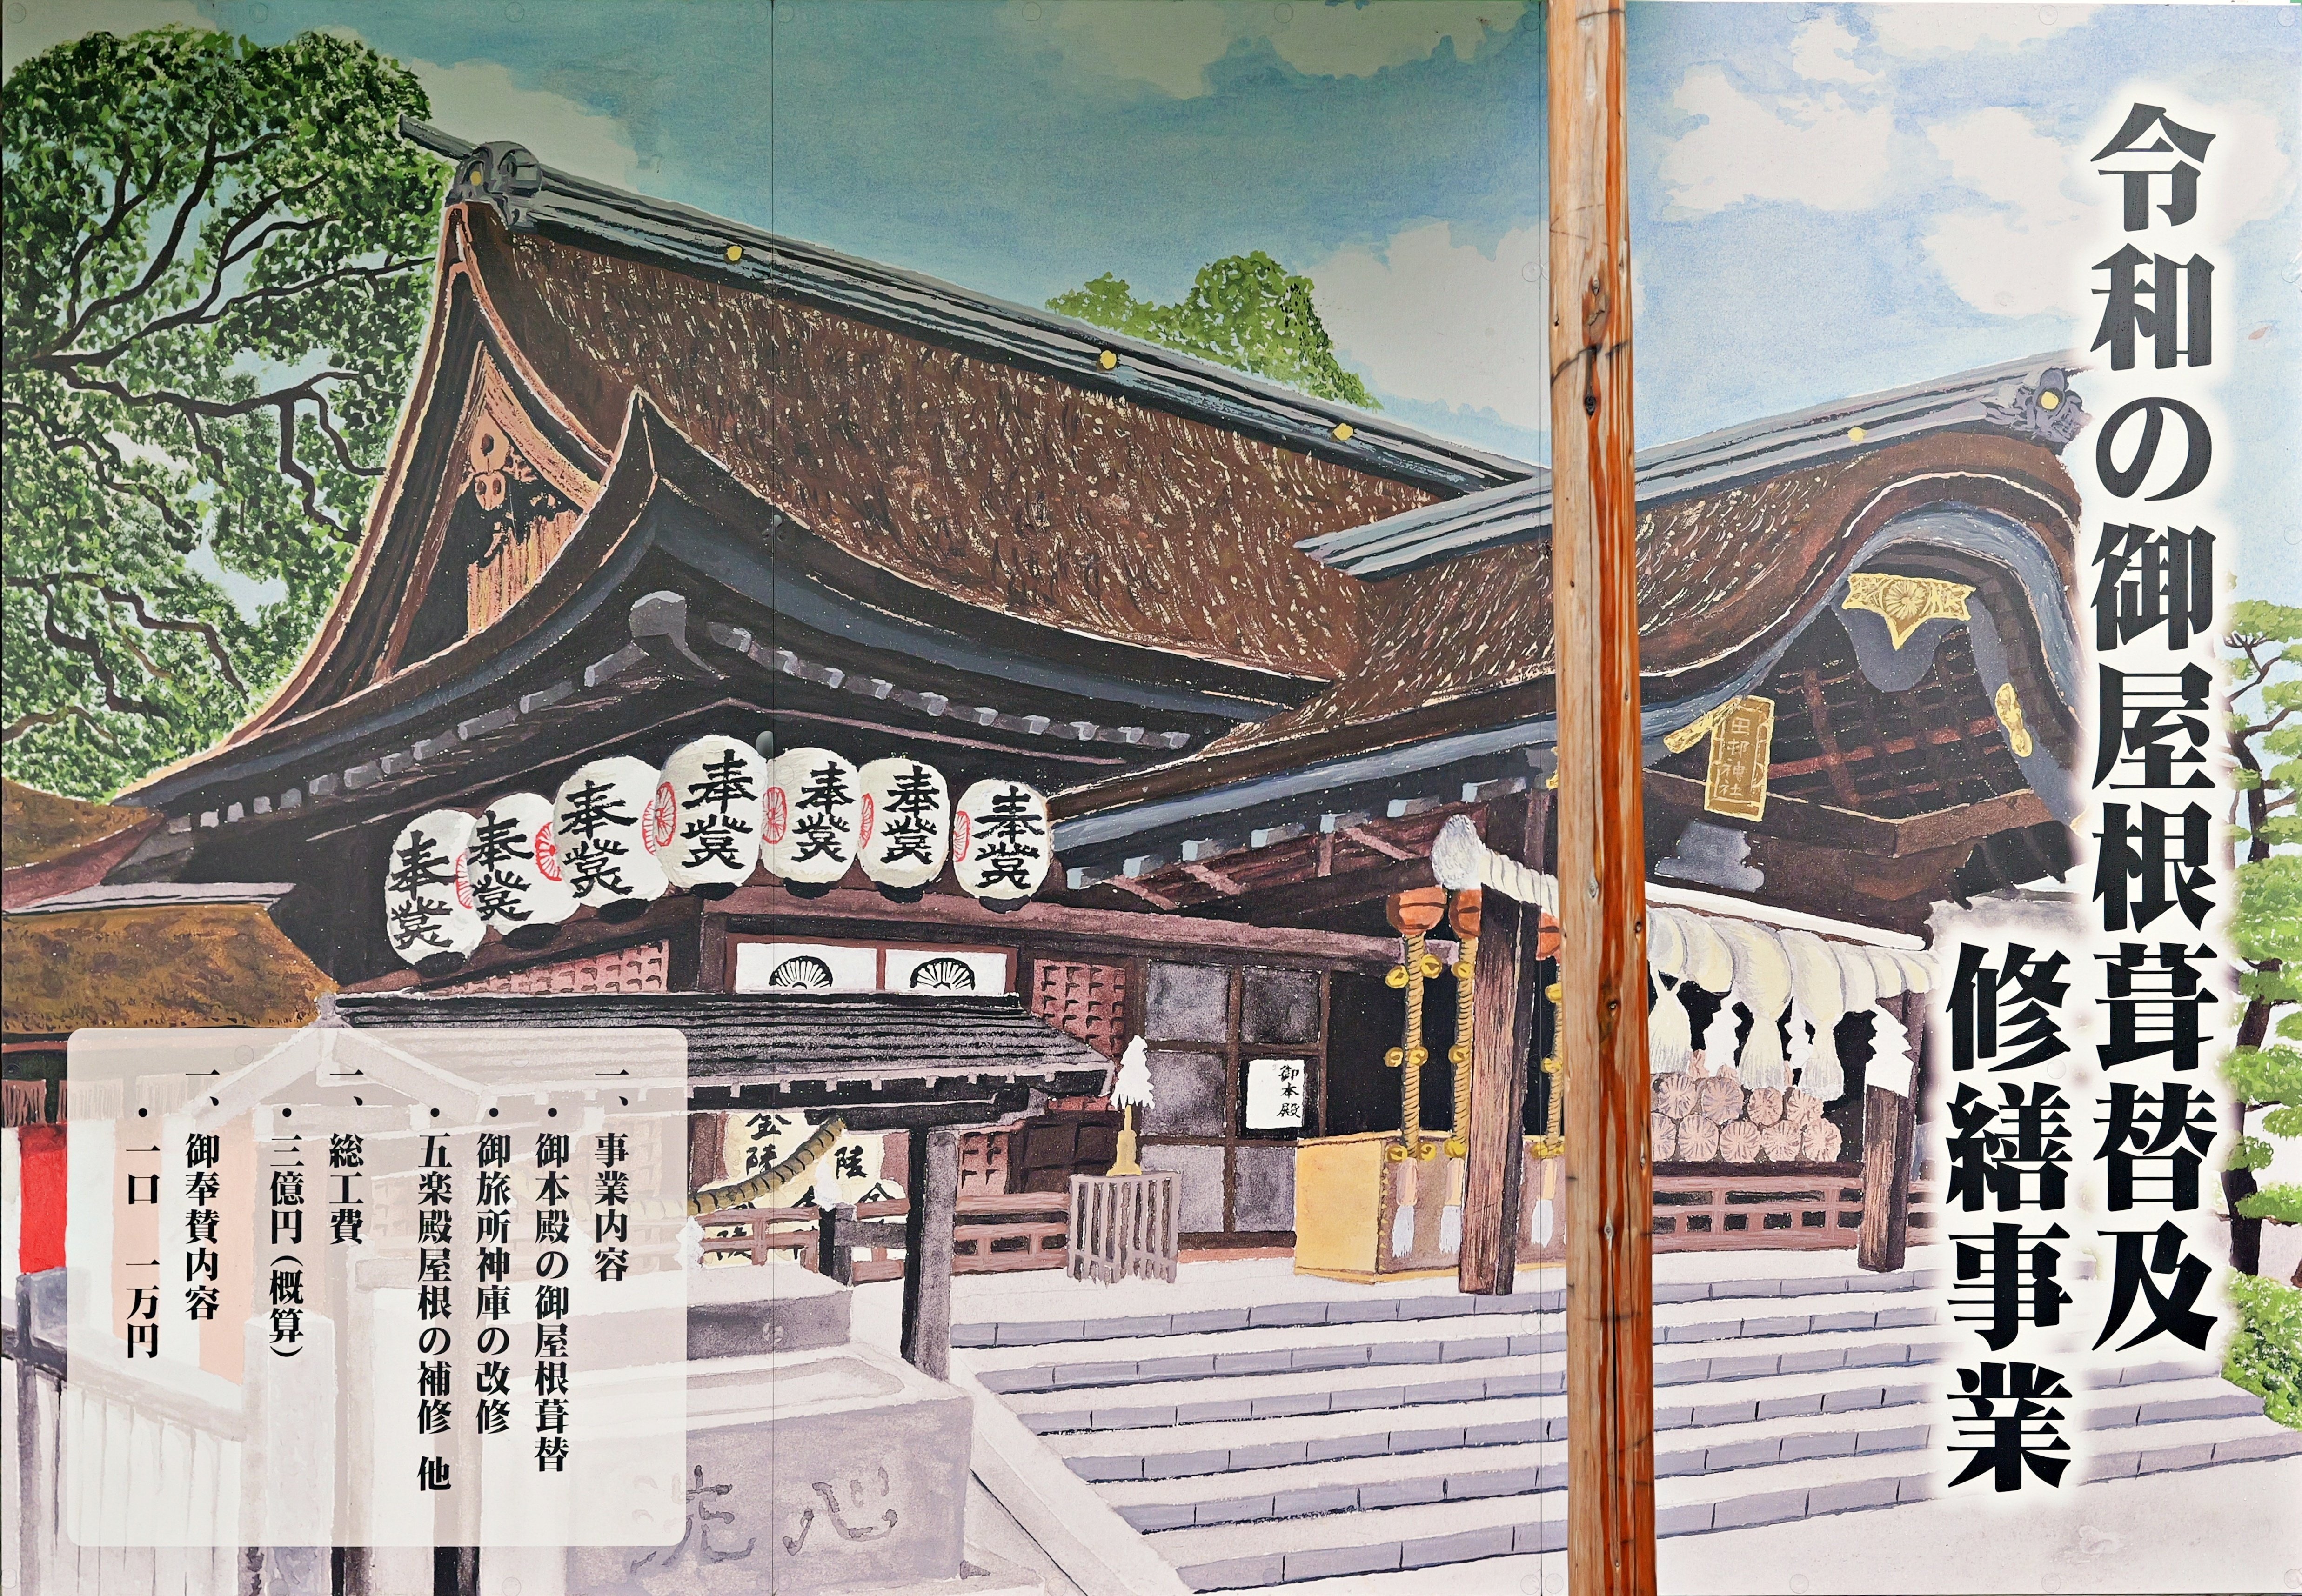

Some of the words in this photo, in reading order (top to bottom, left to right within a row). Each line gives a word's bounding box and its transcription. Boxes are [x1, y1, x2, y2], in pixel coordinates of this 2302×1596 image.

[2090, 102, 2218, 1353] 令和の御屋根葺替及
[1277, 1064, 1301, 1118] 御本殿
[1945, 942, 2073, 1493] 修繕事業
[126, 1260, 160, 1359] 一万円
[417, 1456, 452, 1491] 他
